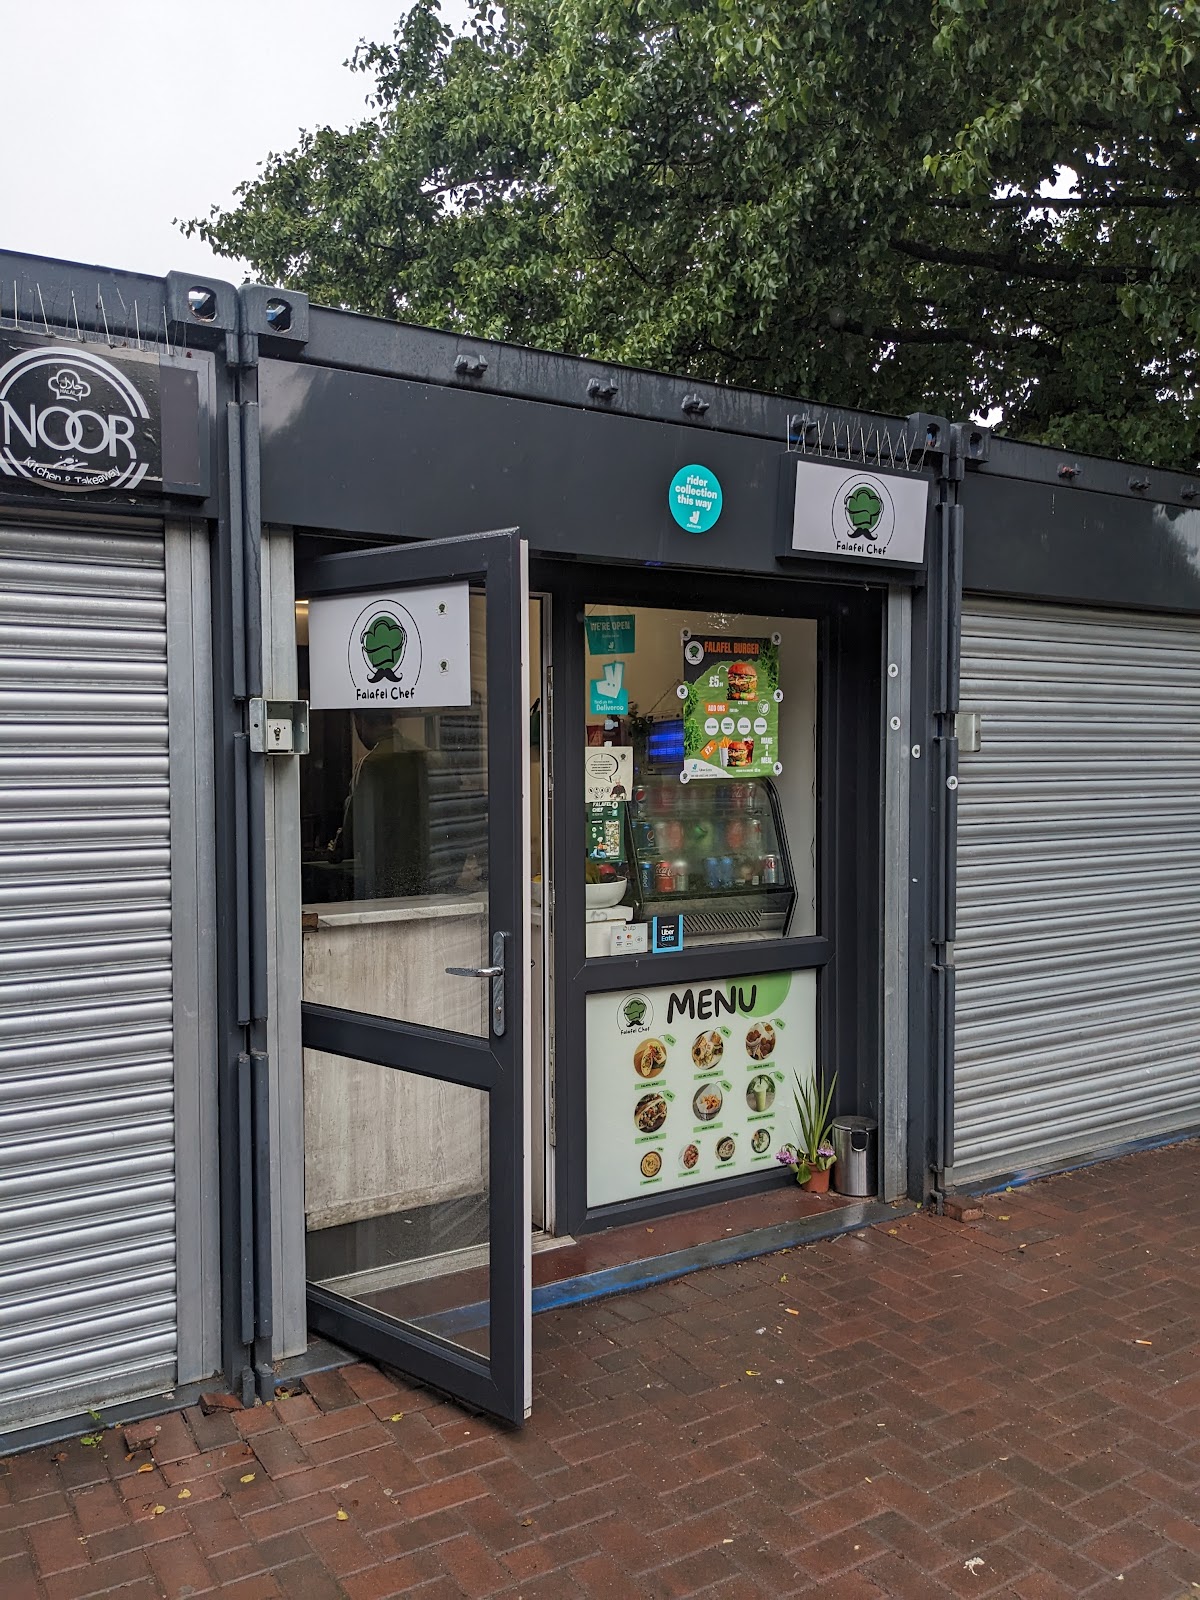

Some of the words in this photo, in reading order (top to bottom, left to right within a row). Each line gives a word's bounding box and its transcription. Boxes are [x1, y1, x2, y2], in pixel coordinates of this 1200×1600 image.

[1, 400, 137, 459] NOOR
[686, 474, 709, 487] rider
[675, 484, 718, 499] collection
[677, 494, 694, 506] this
[695, 499, 712, 511] way
[836, 541, 864, 553] Falafel
[866, 543, 887, 556] Chef
[590, 622, 611, 632] WE'RE
[611, 621, 631, 631] OPEN
[704, 641, 733, 654] FALAFEL
[733, 642, 760, 655] BURGER
[356, 688, 388, 700] Falafel
[390, 686, 415, 700] Chef
[708, 704, 717, 712] ADD
[717, 704, 726, 712] ONS
[667, 984, 757, 1024] MENU
